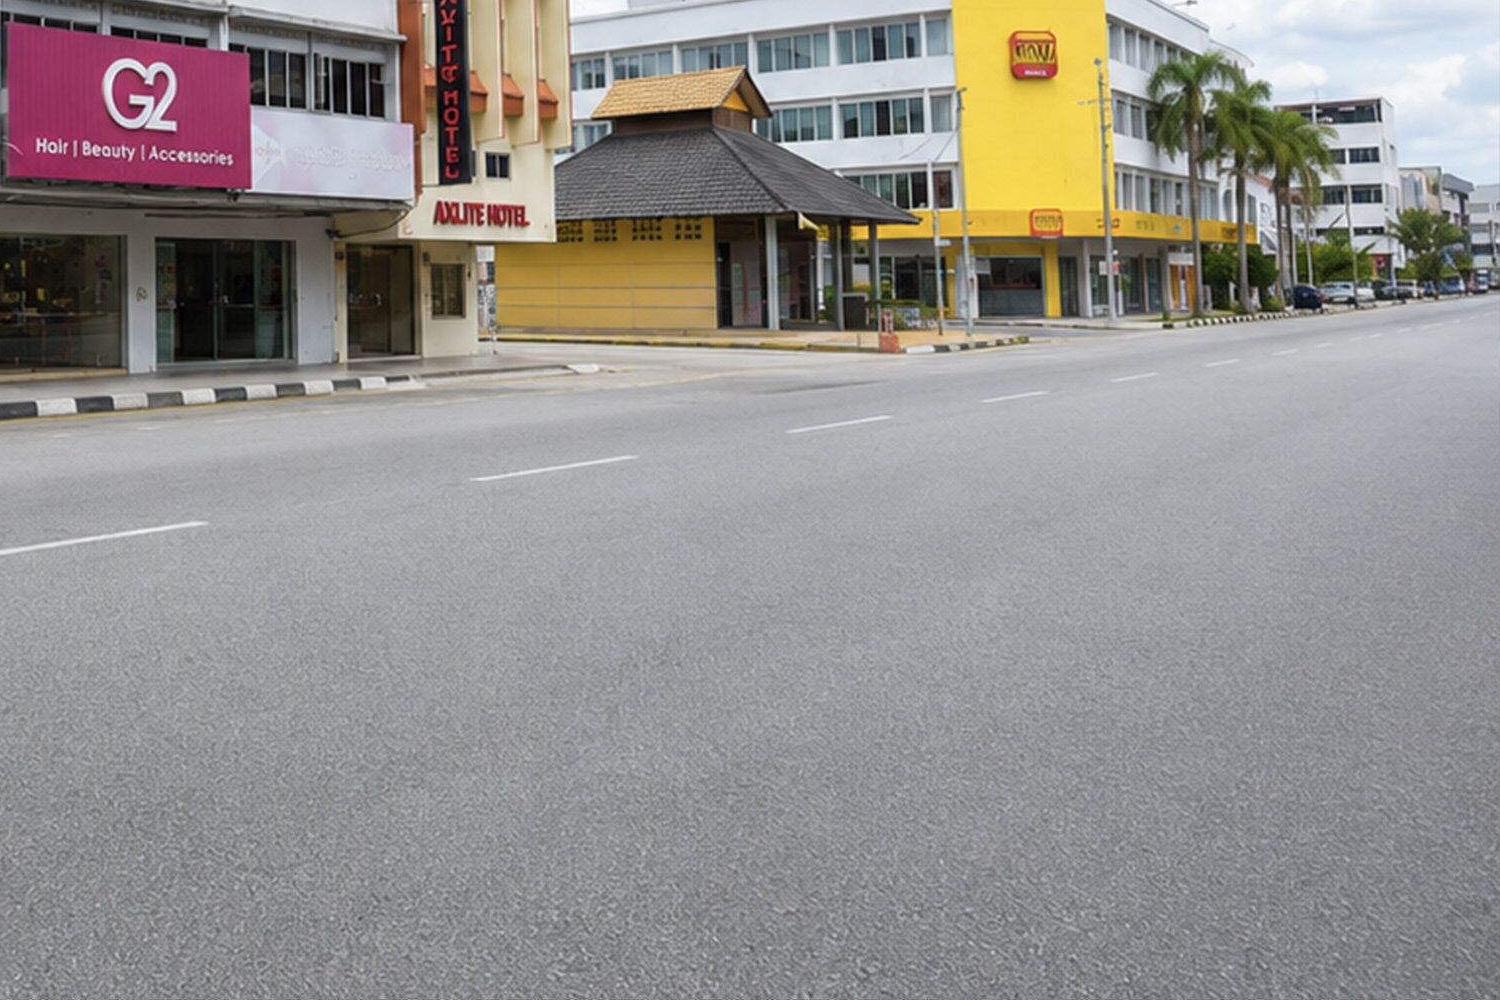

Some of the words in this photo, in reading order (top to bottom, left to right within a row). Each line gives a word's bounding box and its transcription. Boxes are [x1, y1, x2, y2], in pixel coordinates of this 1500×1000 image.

[103, 57, 177, 132] G2
[36, 138, 68, 155] Hair
[82, 140, 135, 161] Beauty
[149, 146, 234, 166] Accessories
[486, 203, 530, 228] HOTEL
